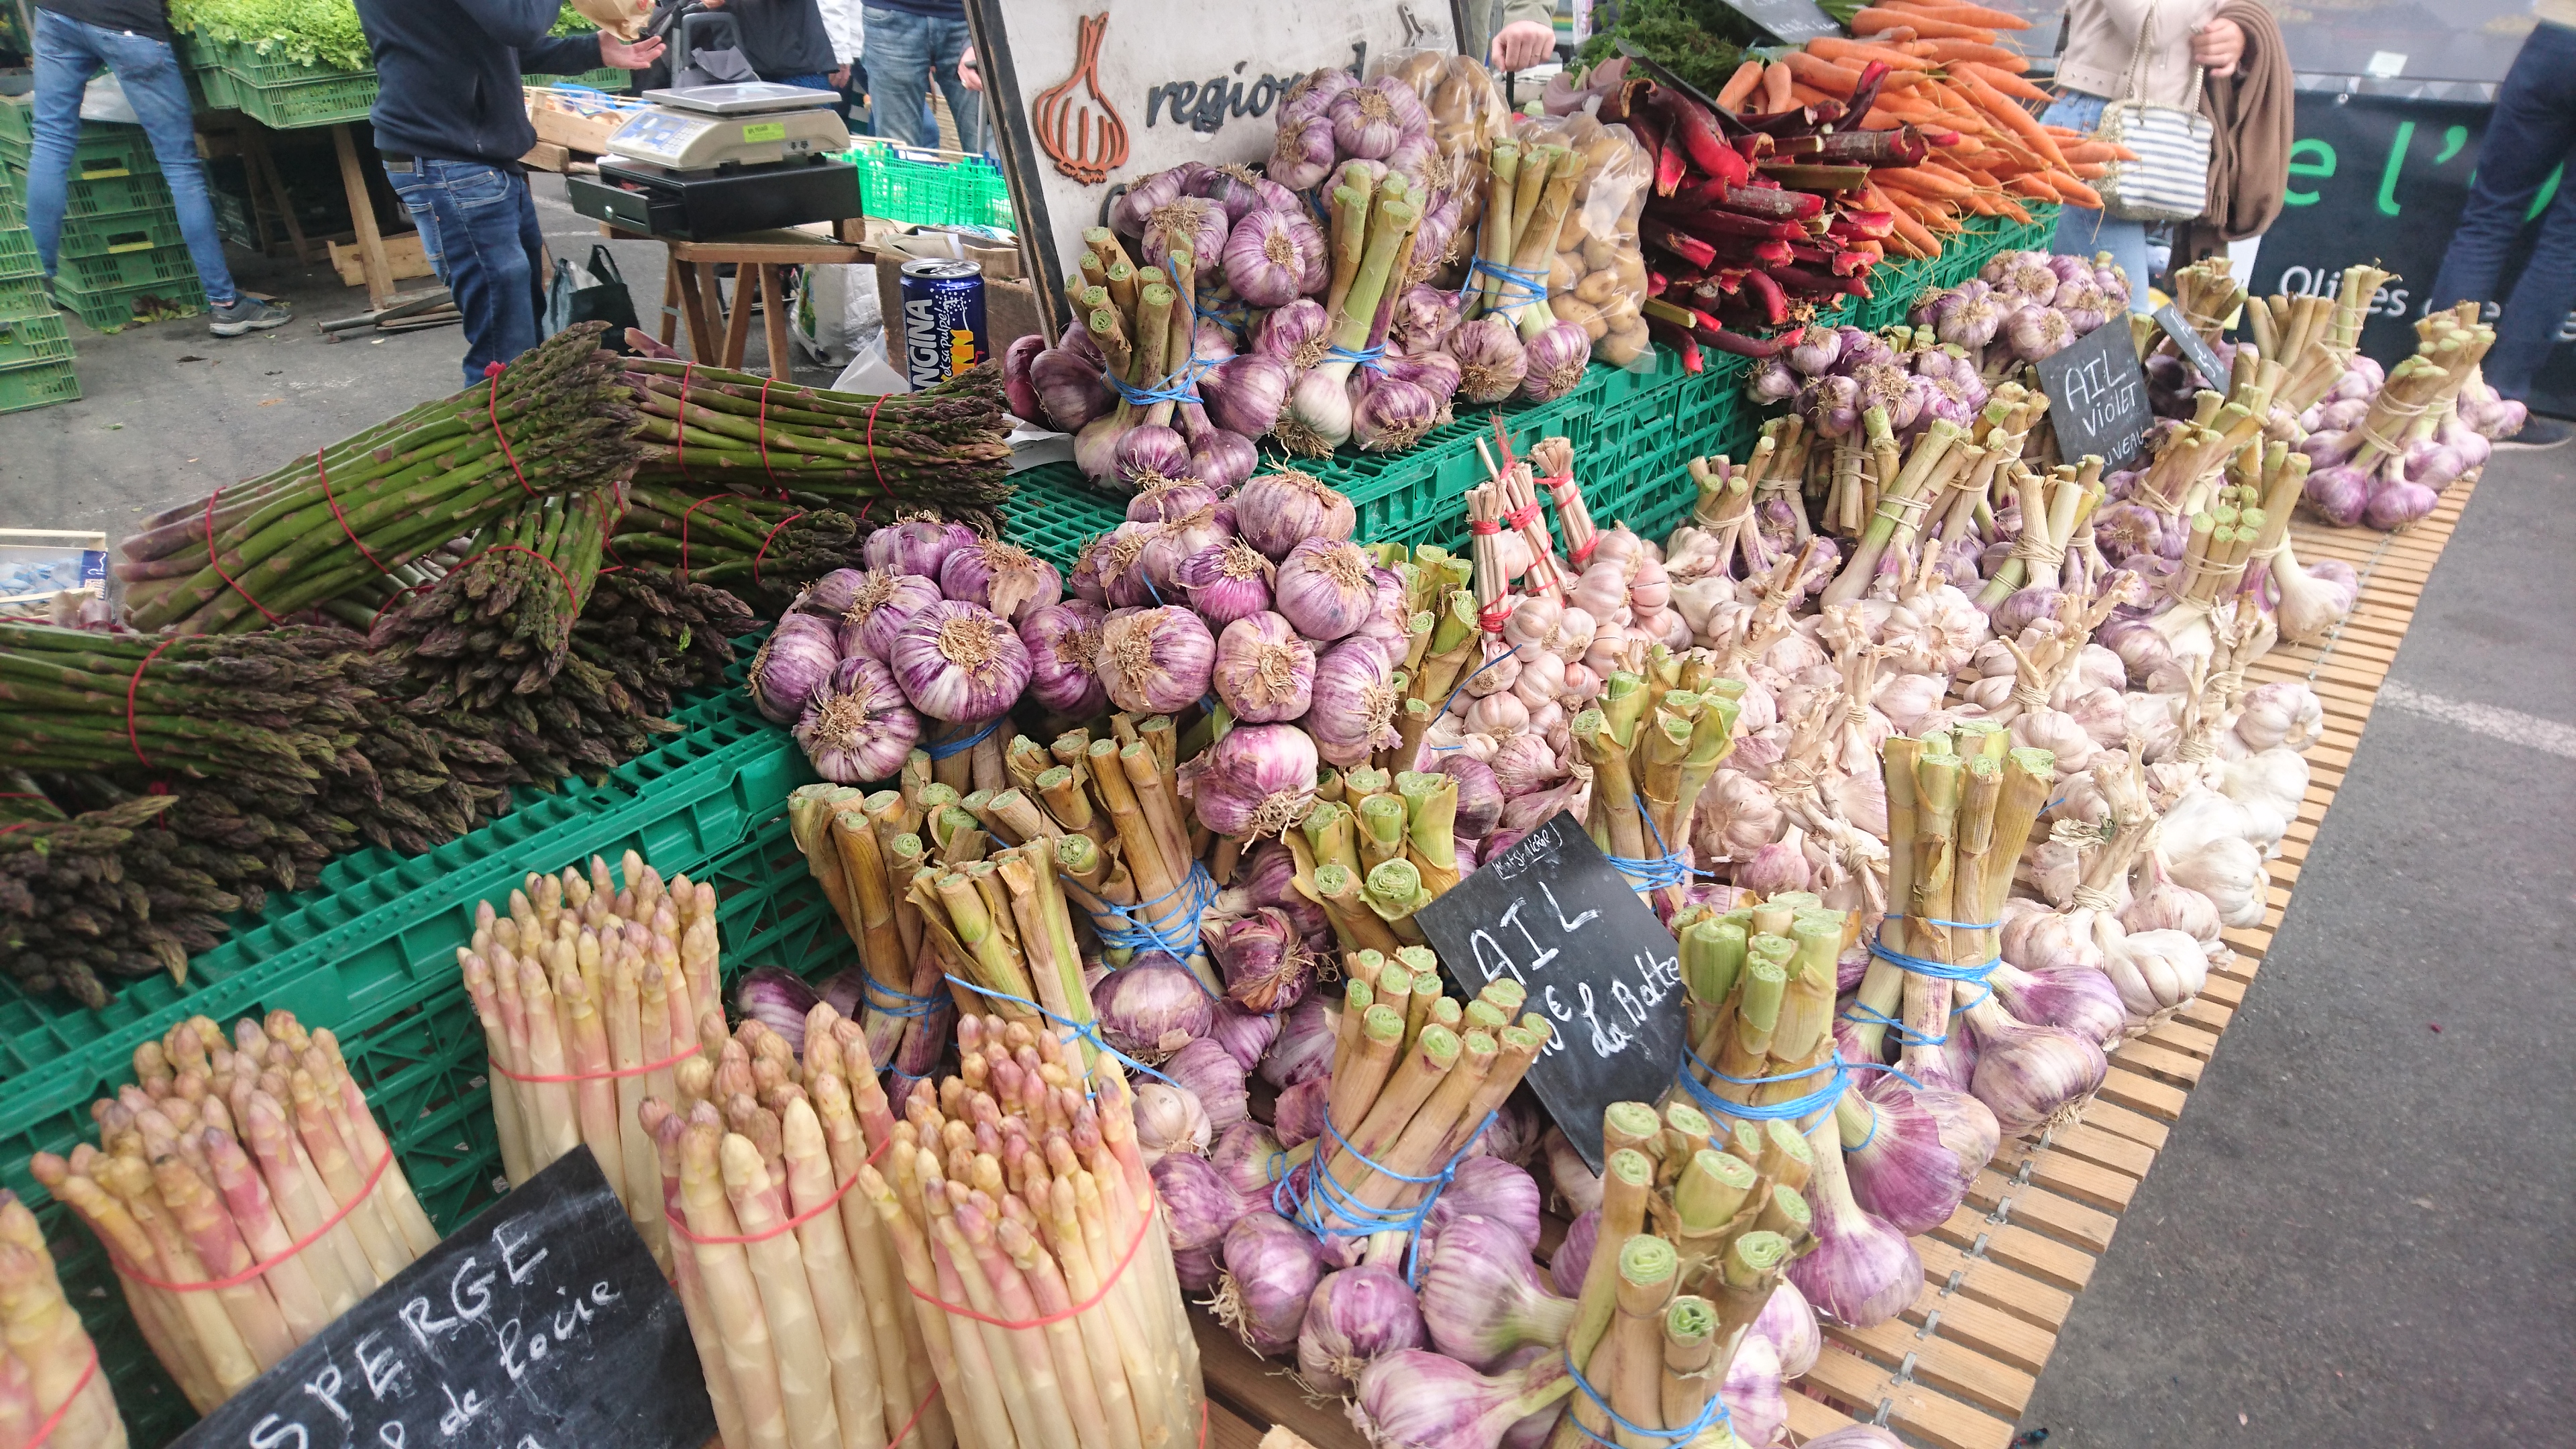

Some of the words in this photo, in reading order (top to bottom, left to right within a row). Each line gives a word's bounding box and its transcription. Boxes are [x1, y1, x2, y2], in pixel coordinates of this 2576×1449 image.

[2279, 266, 2409, 317] Olies
[2065, 349, 2127, 413] AIL
[2101, 426, 2145, 467] UVEAU
[1469, 881, 1600, 987] AIL
